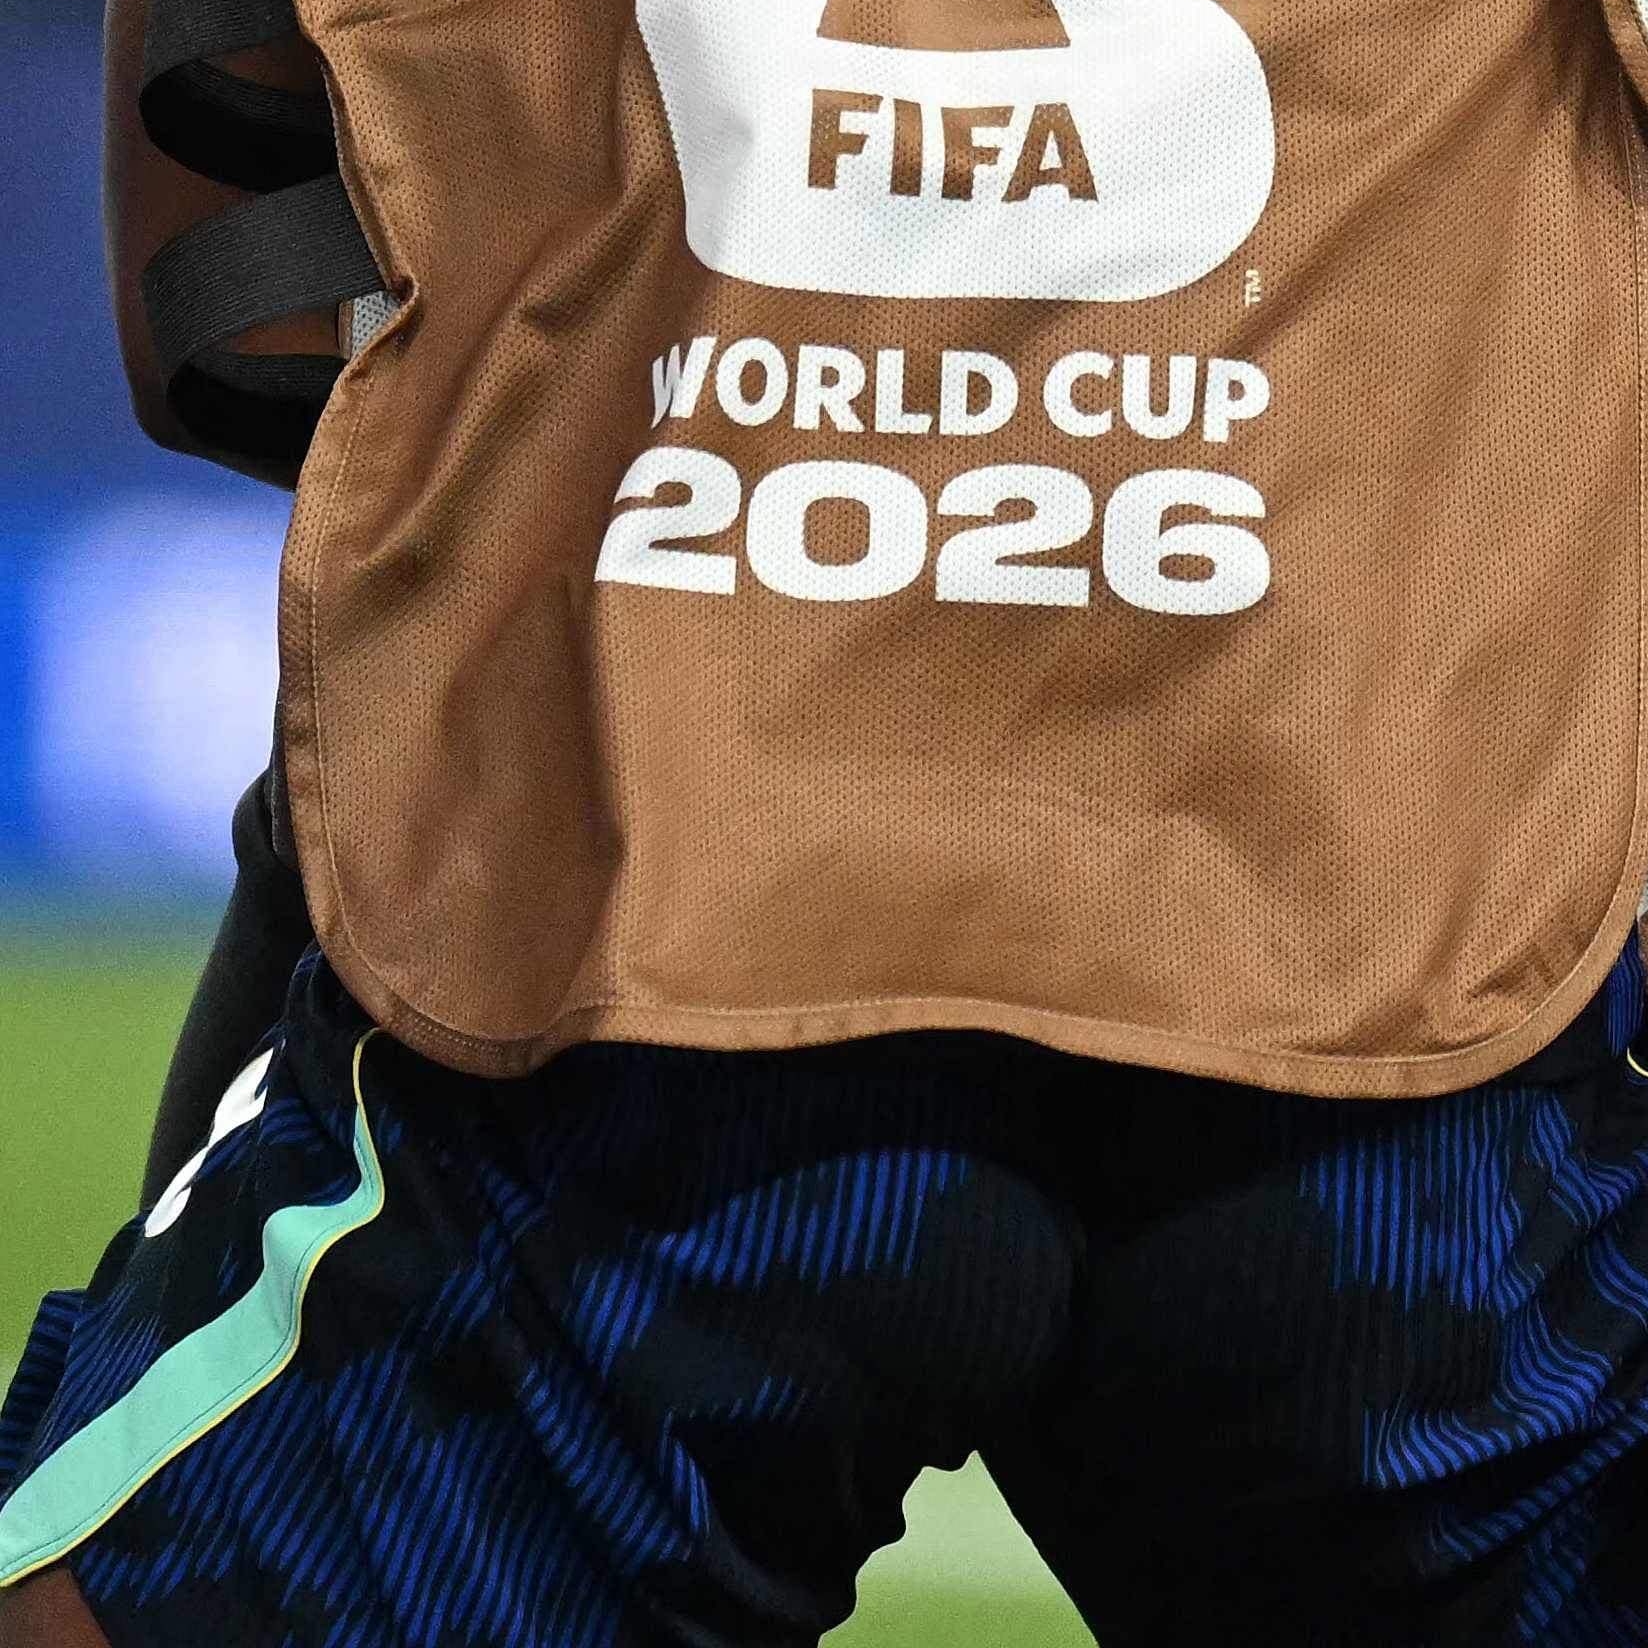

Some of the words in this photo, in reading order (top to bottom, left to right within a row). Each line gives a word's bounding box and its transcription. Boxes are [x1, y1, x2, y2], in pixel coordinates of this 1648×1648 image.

[807, 88, 1099, 203] FIFA
[651, 335, 1019, 436] WORLD
[1043, 350, 1271, 443] CUP
[594, 446, 1271, 616] 2026
